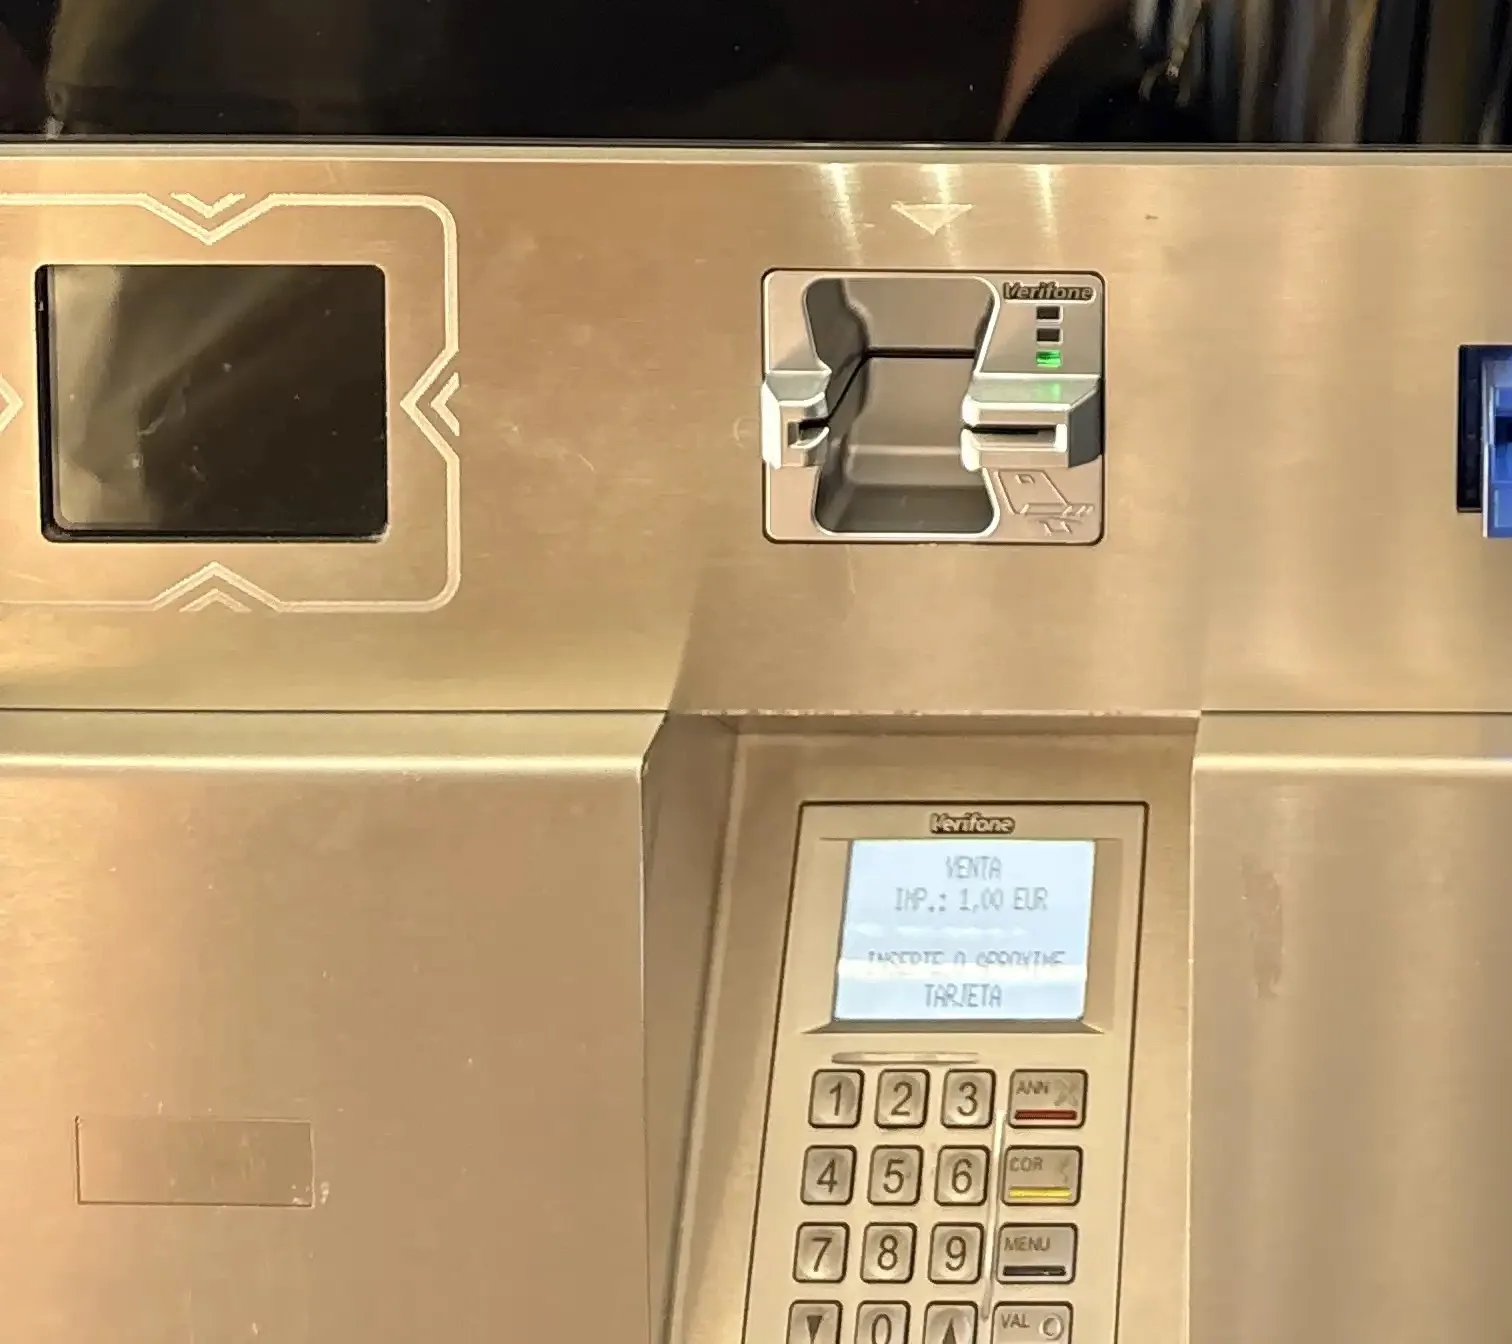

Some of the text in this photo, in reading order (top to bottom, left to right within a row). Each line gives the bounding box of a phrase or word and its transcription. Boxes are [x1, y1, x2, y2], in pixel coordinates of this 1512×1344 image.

[1004, 282, 1095, 300] Verifone
[930, 812, 1015, 834] Verifone
[945, 855, 1002, 880] VENTA
[959, 887, 1003, 913] 1,00
[1013, 887, 1049, 911] EUR
[924, 983, 1002, 1007] TARJETA
[828, 1081, 979, 1116] 1 2 3
[816, 1158, 973, 1194] 4 5 6
[1009, 1156, 1043, 1172] COR
[811, 1234, 967, 1272] 7 8 9
[1003, 1236, 1051, 1252] MENU
[871, 1313, 892, 1344] 0
[1001, 1313, 1031, 1329] VAL
